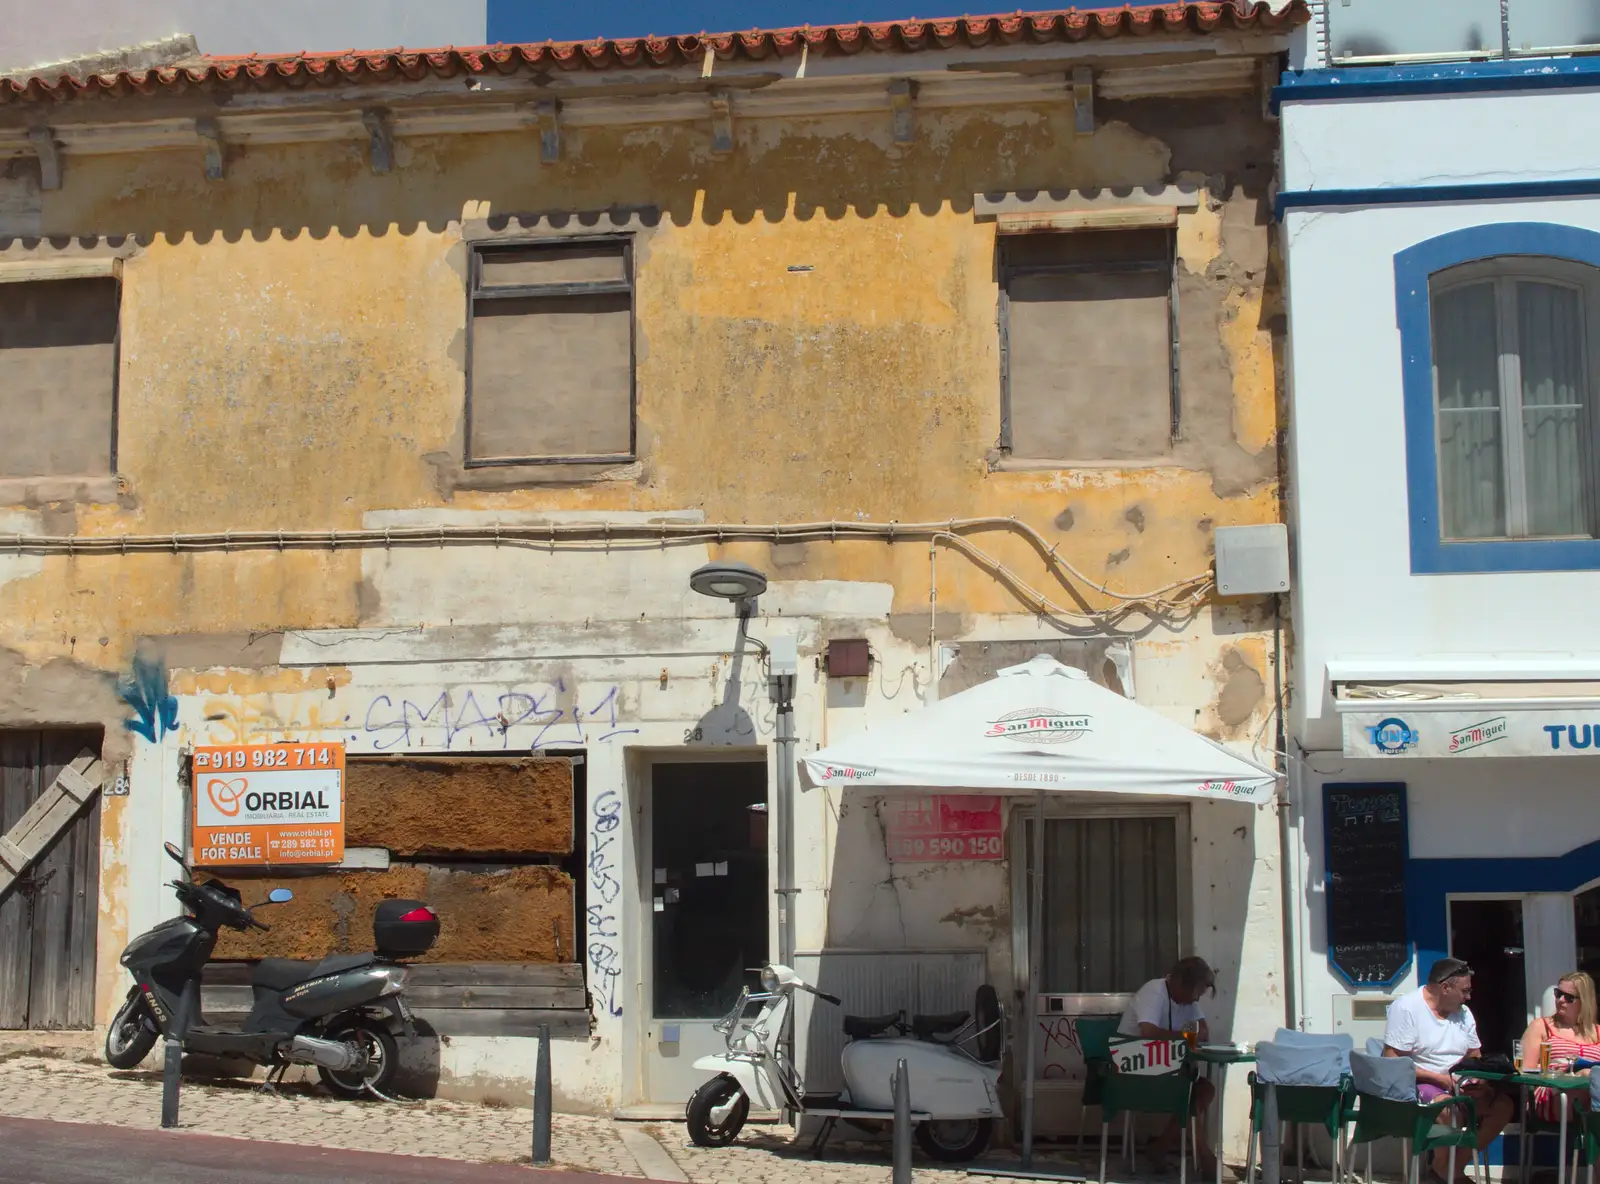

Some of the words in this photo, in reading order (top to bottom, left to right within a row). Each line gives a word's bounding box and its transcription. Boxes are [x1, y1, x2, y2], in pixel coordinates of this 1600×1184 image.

[683, 728, 703, 744] 28
[212, 750, 246, 768] 919
[252, 749, 288, 767] 982
[294, 748, 330, 765] 714
[1014, 772, 1037, 782] DESDE
[1039, 772, 1059, 783] 1890
[245, 790, 330, 811] ORBIAL
[209, 832, 252, 845] VENDE
[279, 829, 333, 838] www.orbial.pt
[281, 839, 298, 848] 289
[300, 839, 317, 848] 582
[319, 838, 335, 847] 151
[929, 837, 964, 855] 590
[968, 836, 1001, 855] 150
[202, 848, 228, 860] FOR
[230, 846, 262, 859] SALE
[279, 849, 334, 858] info@orbial.pt
